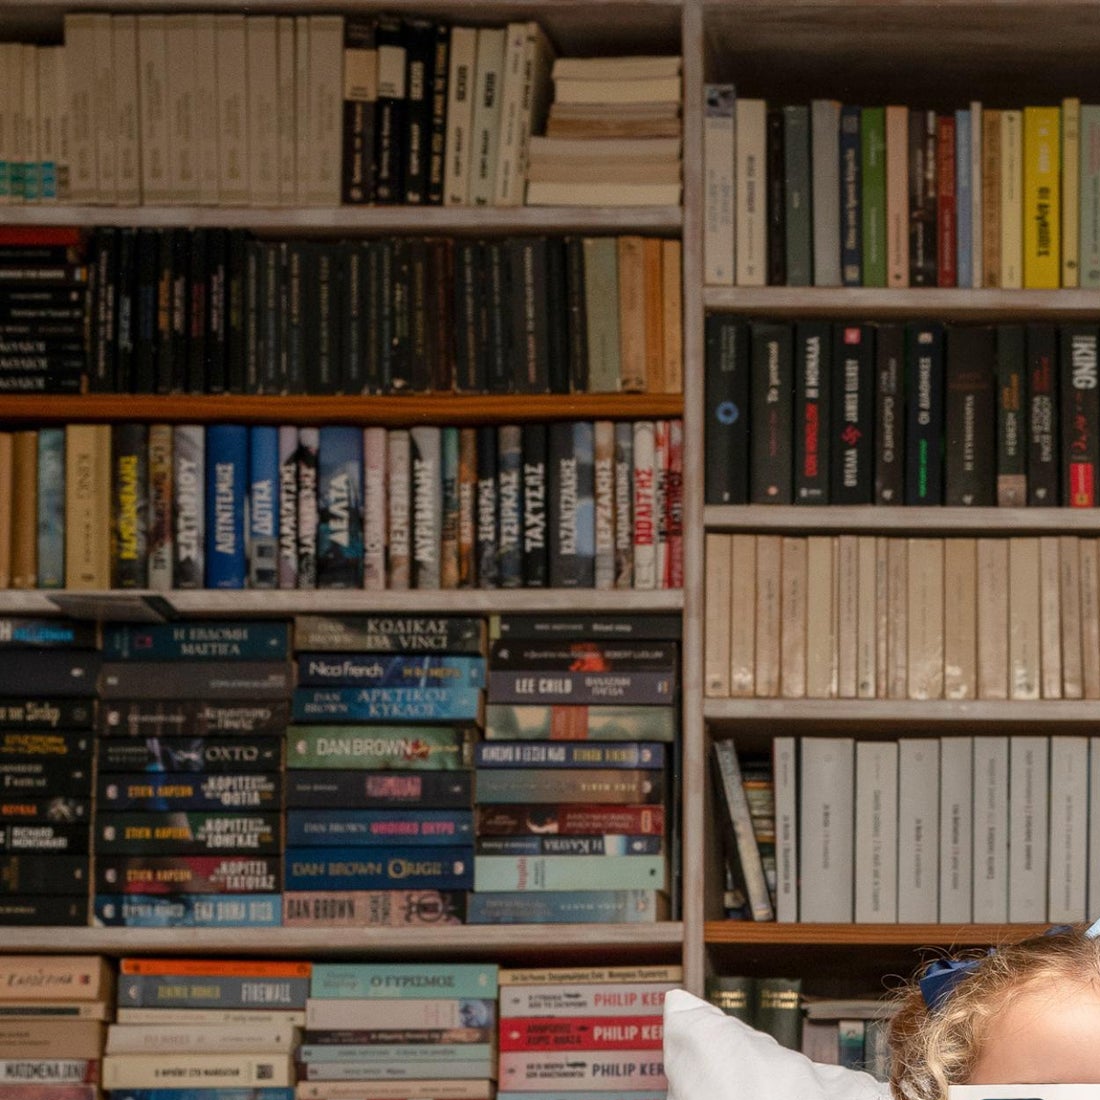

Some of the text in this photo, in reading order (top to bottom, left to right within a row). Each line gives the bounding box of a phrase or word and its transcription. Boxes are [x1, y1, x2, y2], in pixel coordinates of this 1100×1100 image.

[1072, 341, 1097, 389] KING
[177, 458, 197, 562] ΣΩΤΗΡΙΟΥ
[329, 473, 350, 548] ΔΕΛΤΑ
[499, 471, 517, 547] ΤΣΙΡΚΑΣ
[525, 463, 546, 553] ΤΑΧΤΣΗΣ
[560, 458, 578, 556] ΚΑΖΑΝΤΖΑΚΗΣ
[635, 468, 654, 546] ΠΟΛΙΤΗΣ
[367, 635, 449, 649] DA VINCI
[514, 677, 573, 694] LEE CHILD
[317, 738, 414, 756] DAN BROWN
[291, 861, 383, 876] DAN BROWN
[286, 899, 355, 919] DAN BROWN
[241, 982, 291, 1003] FIREWALL
[594, 992, 664, 1008] PHILIP KER
[593, 1025, 663, 1041] PHILIP KE
[592, 1062, 665, 1077] PHILIP KER
